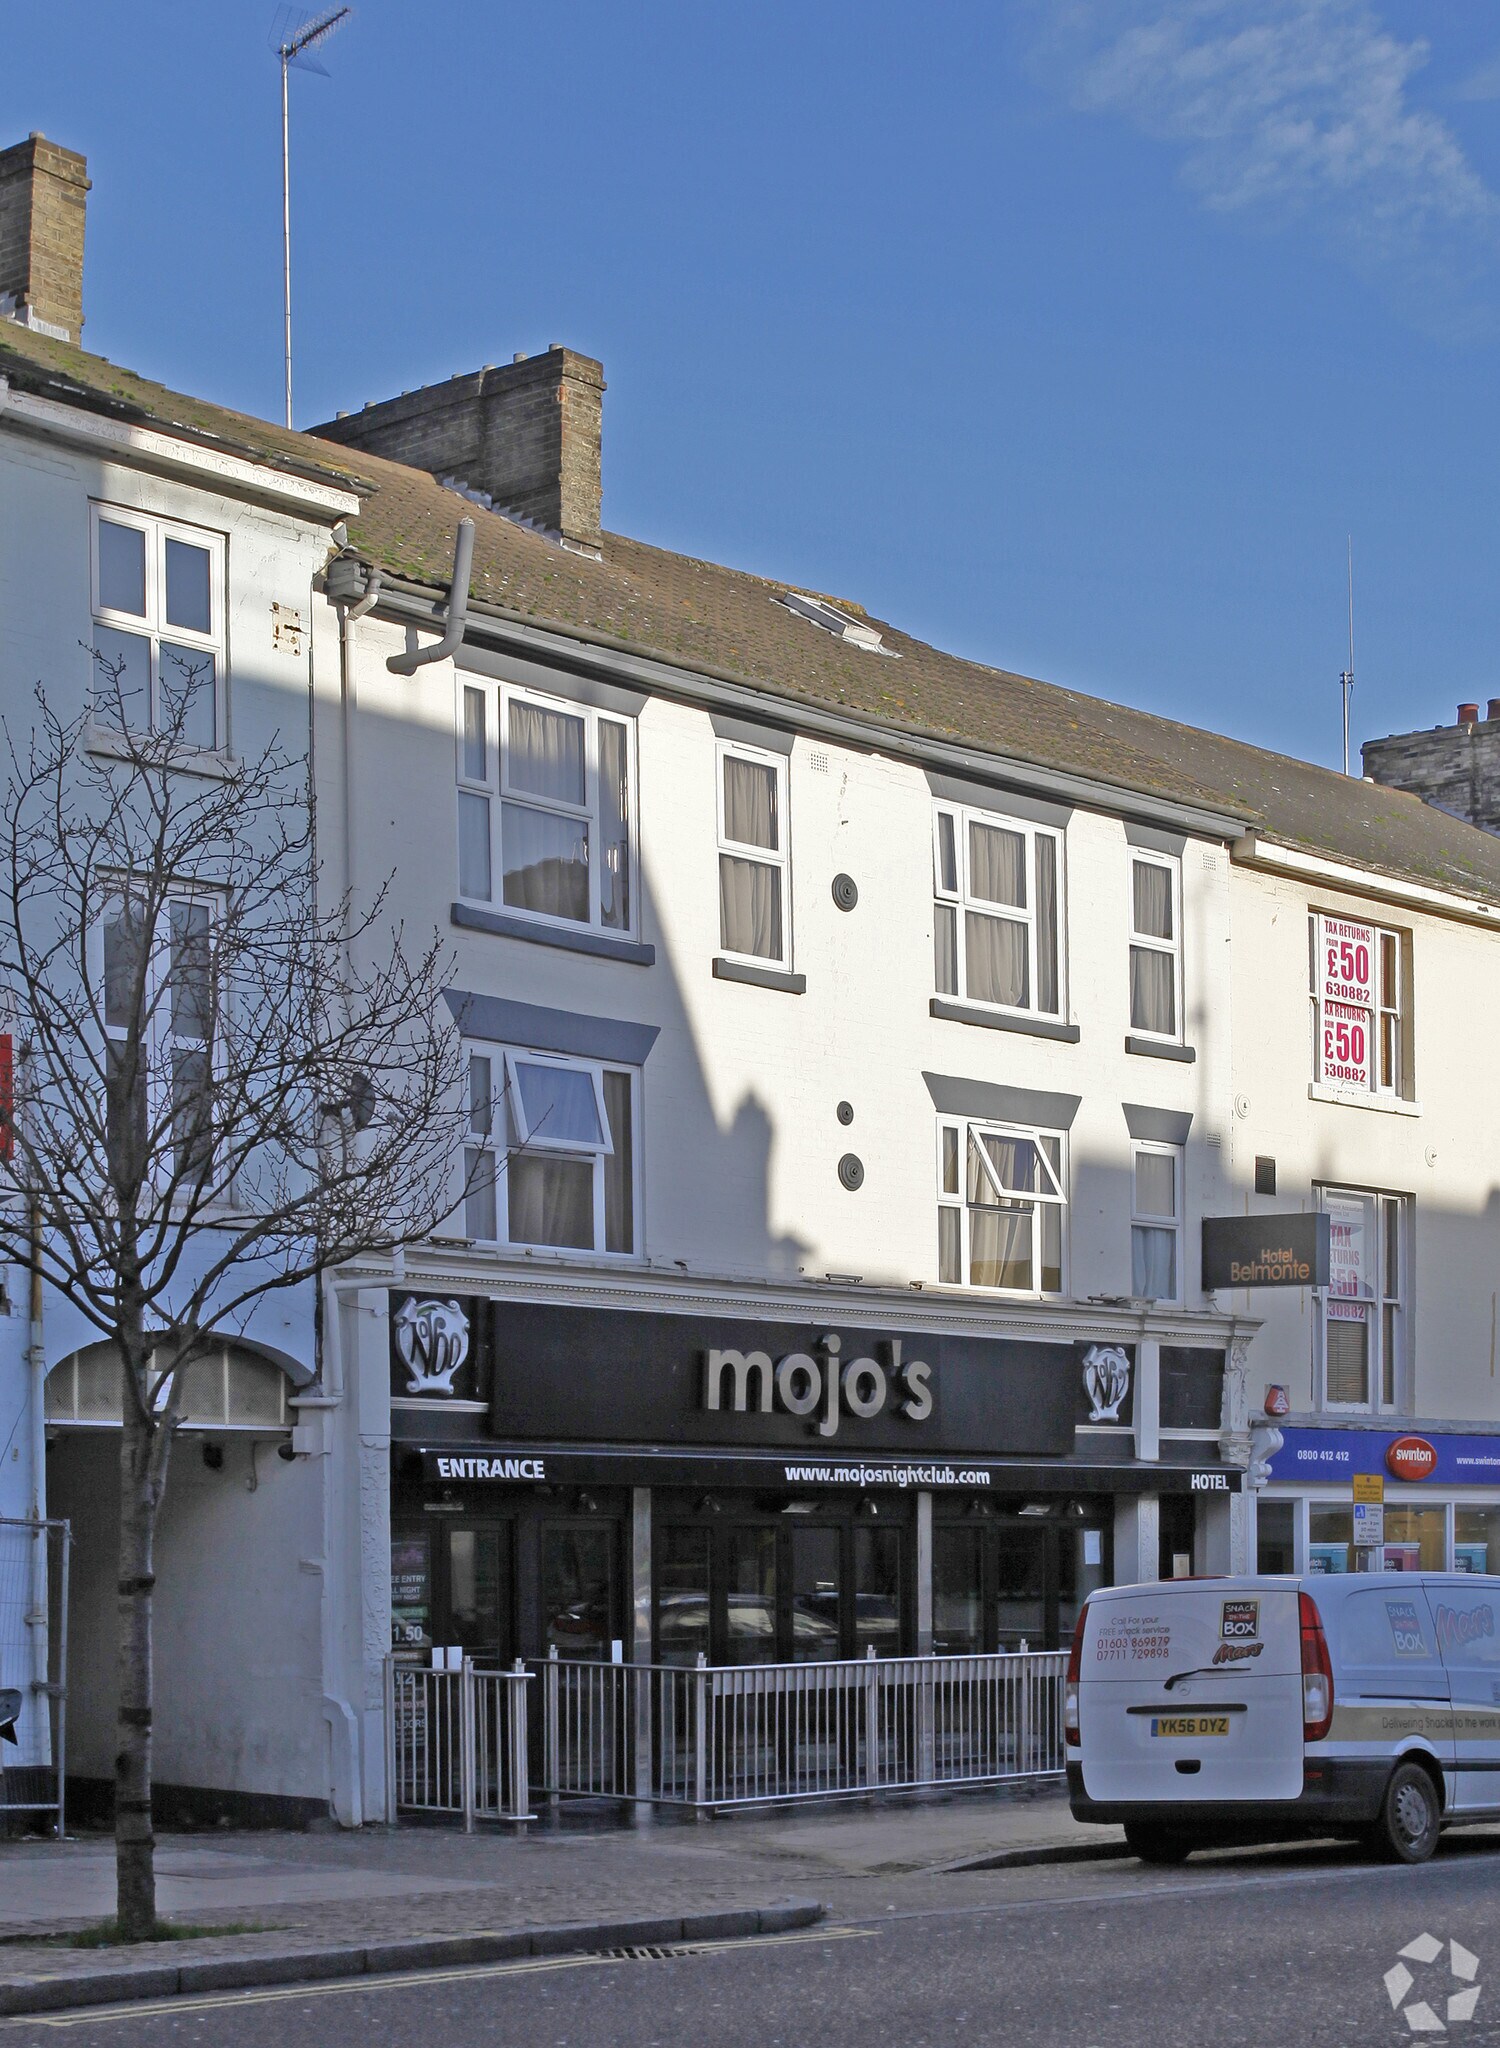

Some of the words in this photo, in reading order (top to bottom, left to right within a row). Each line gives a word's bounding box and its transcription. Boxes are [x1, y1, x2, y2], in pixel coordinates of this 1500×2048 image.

[1324, 919, 1338, 935] TAX
[1338, 923, 1370, 943] RETURNS
[1327, 941, 1369, 985] £50
[1325, 981, 1370, 1003] 630882
[1324, 1001, 1334, 1016] AX
[1334, 1003, 1366, 1023] RETURNS
[1324, 1023, 1365, 1065] £50
[1330, 1225, 1351, 1247] TAX
[1261, 1247, 1293, 1264] Hotel
[1330, 1248, 1360, 1266] TURNS
[1230, 1259, 1310, 1282] Belmonte
[1327, 1304, 1365, 1319] 30882
[706, 1333, 933, 1437] mojo's
[1297, 1449, 1318, 1460] 0800
[1319, 1450, 1334, 1461] 412
[1335, 1451, 1350, 1462] 412
[1396, 1447, 1432, 1462] swinton
[437, 1457, 546, 1479] ENTRANCE
[784, 1464, 991, 1487] www.mojosnightclub.com
[1190, 1473, 1230, 1490] HOTEL
[401, 1575, 426, 1583] ENTRY
[399, 1586, 421, 1594] NIGHT
[1225, 1603, 1256, 1613] SNACK
[1387, 1605, 1416, 1617] SNACK
[1111, 1617, 1127, 1626] Call
[1127, 1616, 1141, 1625] For
[1141, 1616, 1160, 1626] your
[1224, 1621, 1256, 1635] BOX
[1435, 1602, 1494, 1654] Mars
[392, 1625, 423, 1642] 1.50
[1099, 1627, 1117, 1636] FREE
[1142, 1626, 1171, 1635] service
[1096, 1638, 1129, 1650] 01603
[1131, 1636, 1171, 1648] 869879
[1394, 1631, 1424, 1650] BOX
[1096, 1650, 1127, 1661] 07711
[1130, 1648, 1170, 1660] 729898
[1212, 1642, 1264, 1665] Mars
[1160, 1719, 1196, 1735] YK56
[1199, 1718, 1228, 1734] OYZ
[1382, 1716, 1424, 1731] Delivering
[1424, 1716, 1455, 1729] Snacks
[1464, 1717, 1477, 1729] the
[1477, 1718, 1497, 1729] work
